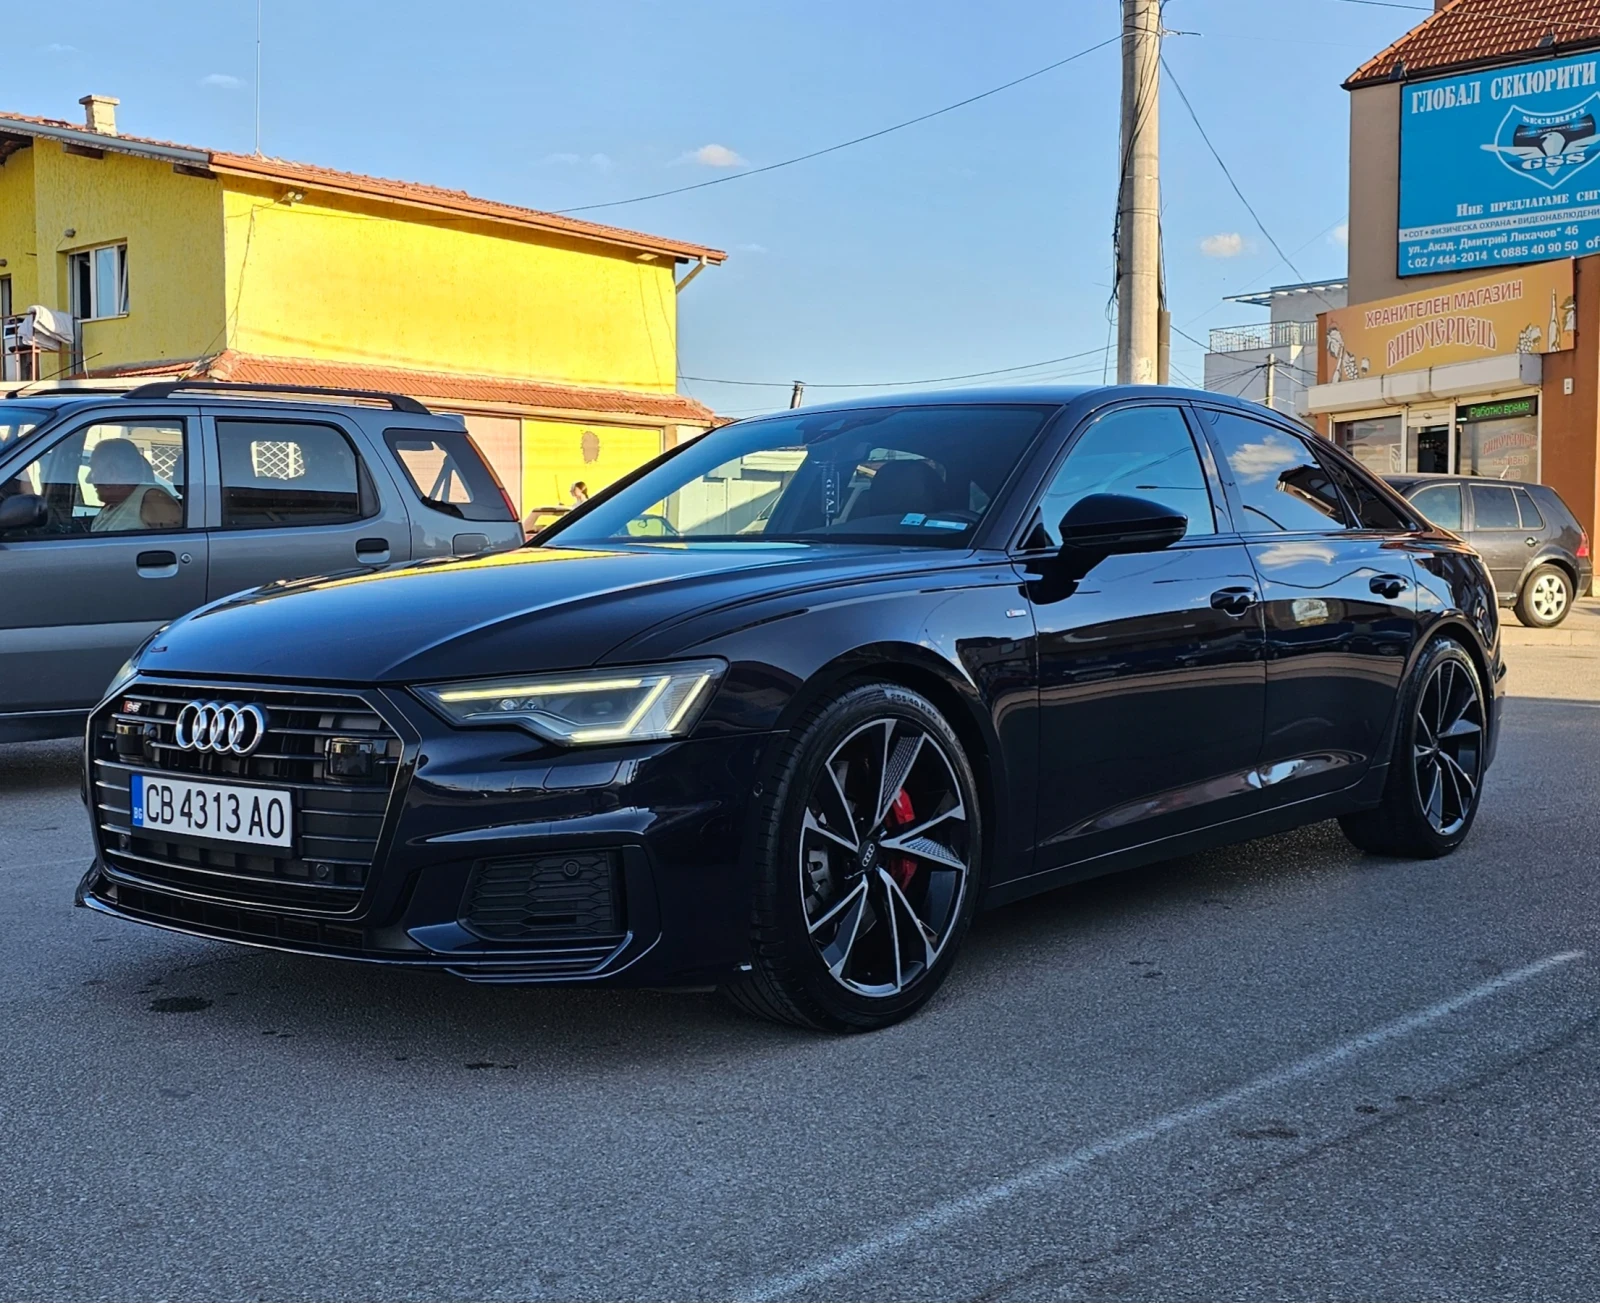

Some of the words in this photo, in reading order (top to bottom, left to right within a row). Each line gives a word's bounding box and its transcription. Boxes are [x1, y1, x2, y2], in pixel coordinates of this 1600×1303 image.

[1411, 81, 1481, 114] ГЛОБАЛ
[1490, 61, 1597, 100] СЕКЮРИТИ
[1522, 106, 1587, 125] SECURITY
[1521, 152, 1586, 170] GSS
[1490, 193, 1570, 213] ПРЕДЛАГАМЕ
[1430, 223, 1478, 235] ФИЗИЧЕСКА
[1479, 219, 1512, 230] ОХРАНА
[1459, 233, 1508, 250] Дмитрий
[1564, 225, 1579, 236] 46
[1414, 257, 1428, 268] 02
[1437, 250, 1488, 265] 444-2014
[1501, 245, 1529, 258] 0885
[1531, 244, 1545, 254] 40
[1547, 242, 1562, 253] 90
[1564, 240, 1579, 251] 50
[1365, 296, 1450, 328] ХРАНИТЕЛЕН
[1454, 280, 1522, 310] МАГАЗИН
[1470, 405, 1503, 418] Работно
[1503, 401, 1530, 415] време
[133, 806, 144, 820] BG
[146, 784, 174, 825] CB
[180, 788, 241, 834] 4313
[248, 795, 285, 839] AO
